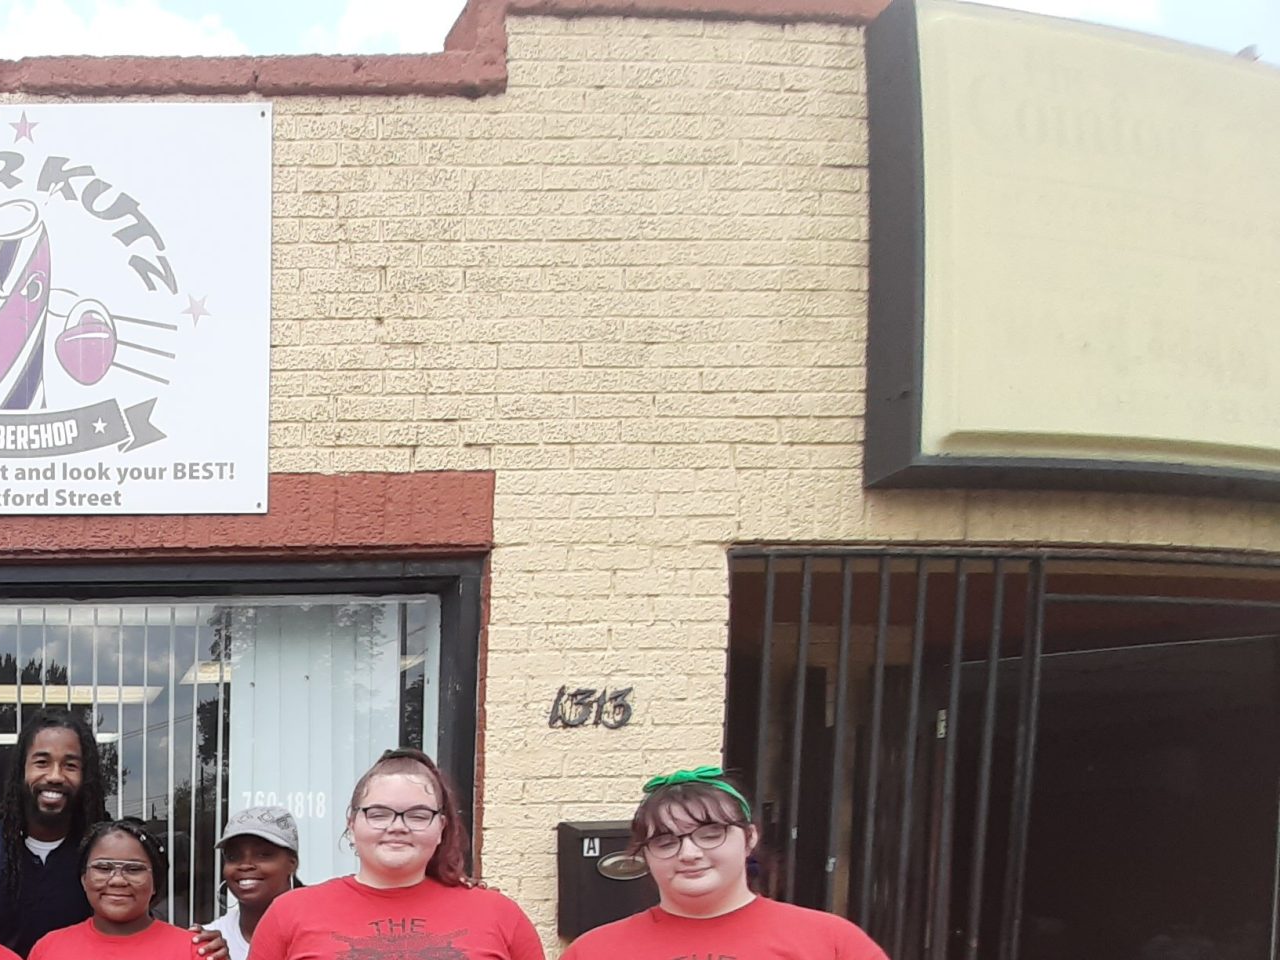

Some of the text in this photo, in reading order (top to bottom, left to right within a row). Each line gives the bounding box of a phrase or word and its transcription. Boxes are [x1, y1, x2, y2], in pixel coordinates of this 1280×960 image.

[37, 156, 178, 295] KUTZ
[14, 462, 56, 481] and
[62, 462, 111, 480] look
[116, 465, 167, 485] your
[173, 462, 235, 480] BEST!
[55, 488, 122, 507] Street
[548, 685, 633, 729] 1313
[586, 836, 598, 855] A
[368, 918, 427, 936] THE
